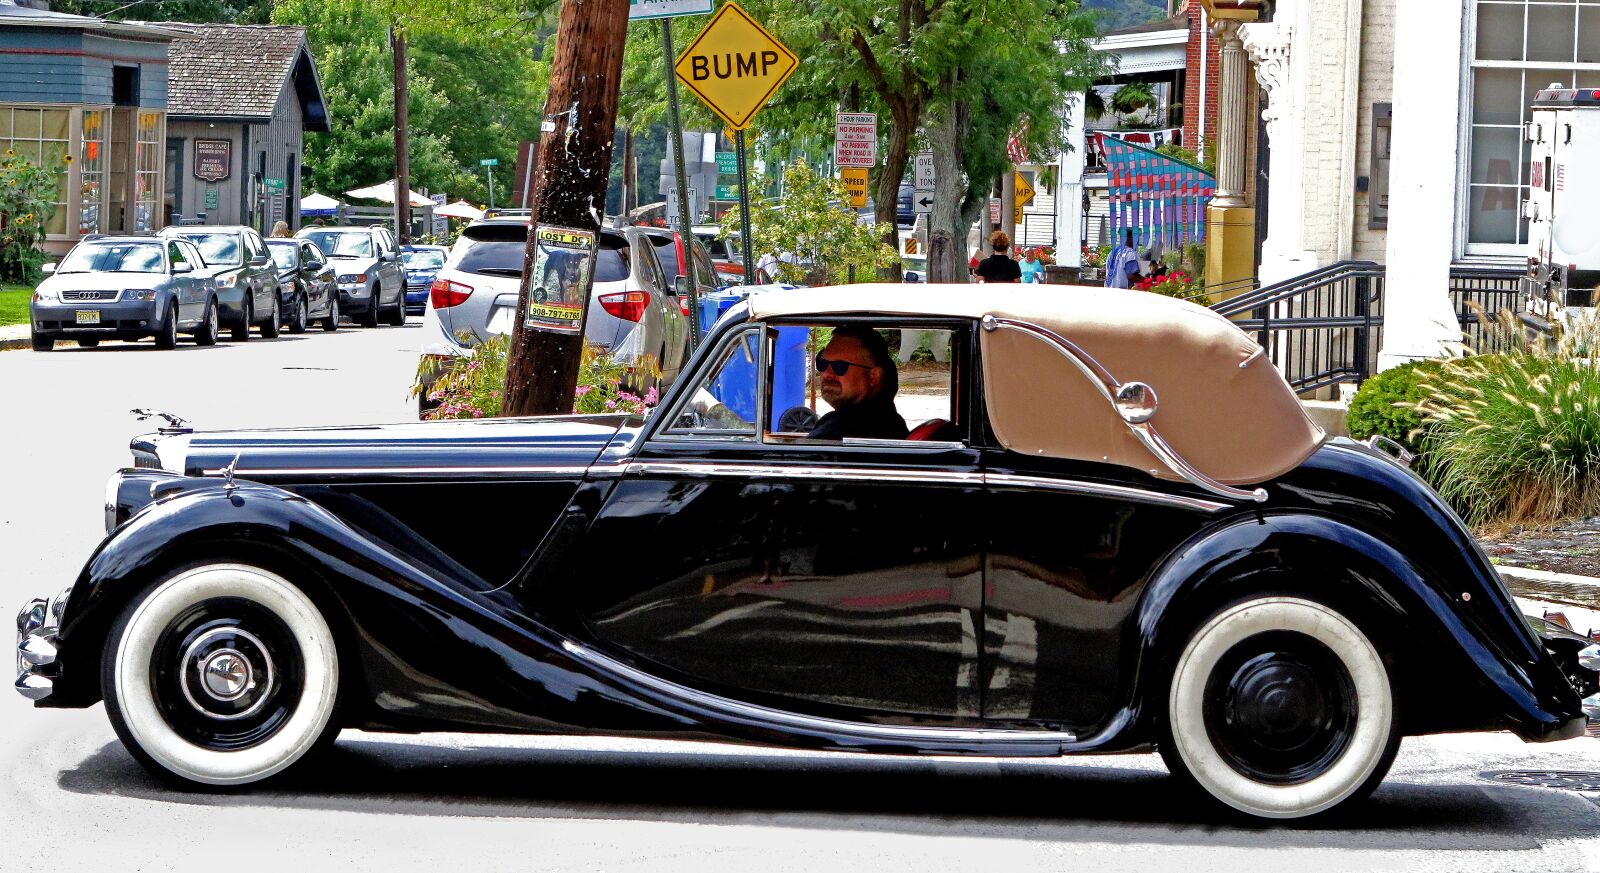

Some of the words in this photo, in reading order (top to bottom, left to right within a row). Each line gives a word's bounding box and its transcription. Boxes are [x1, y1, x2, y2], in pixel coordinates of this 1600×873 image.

[691, 50, 779, 81] BUMP
[919, 158, 932, 166] OVE
[1016, 188, 1030, 197] MP
[540, 232, 566, 244] LOST
